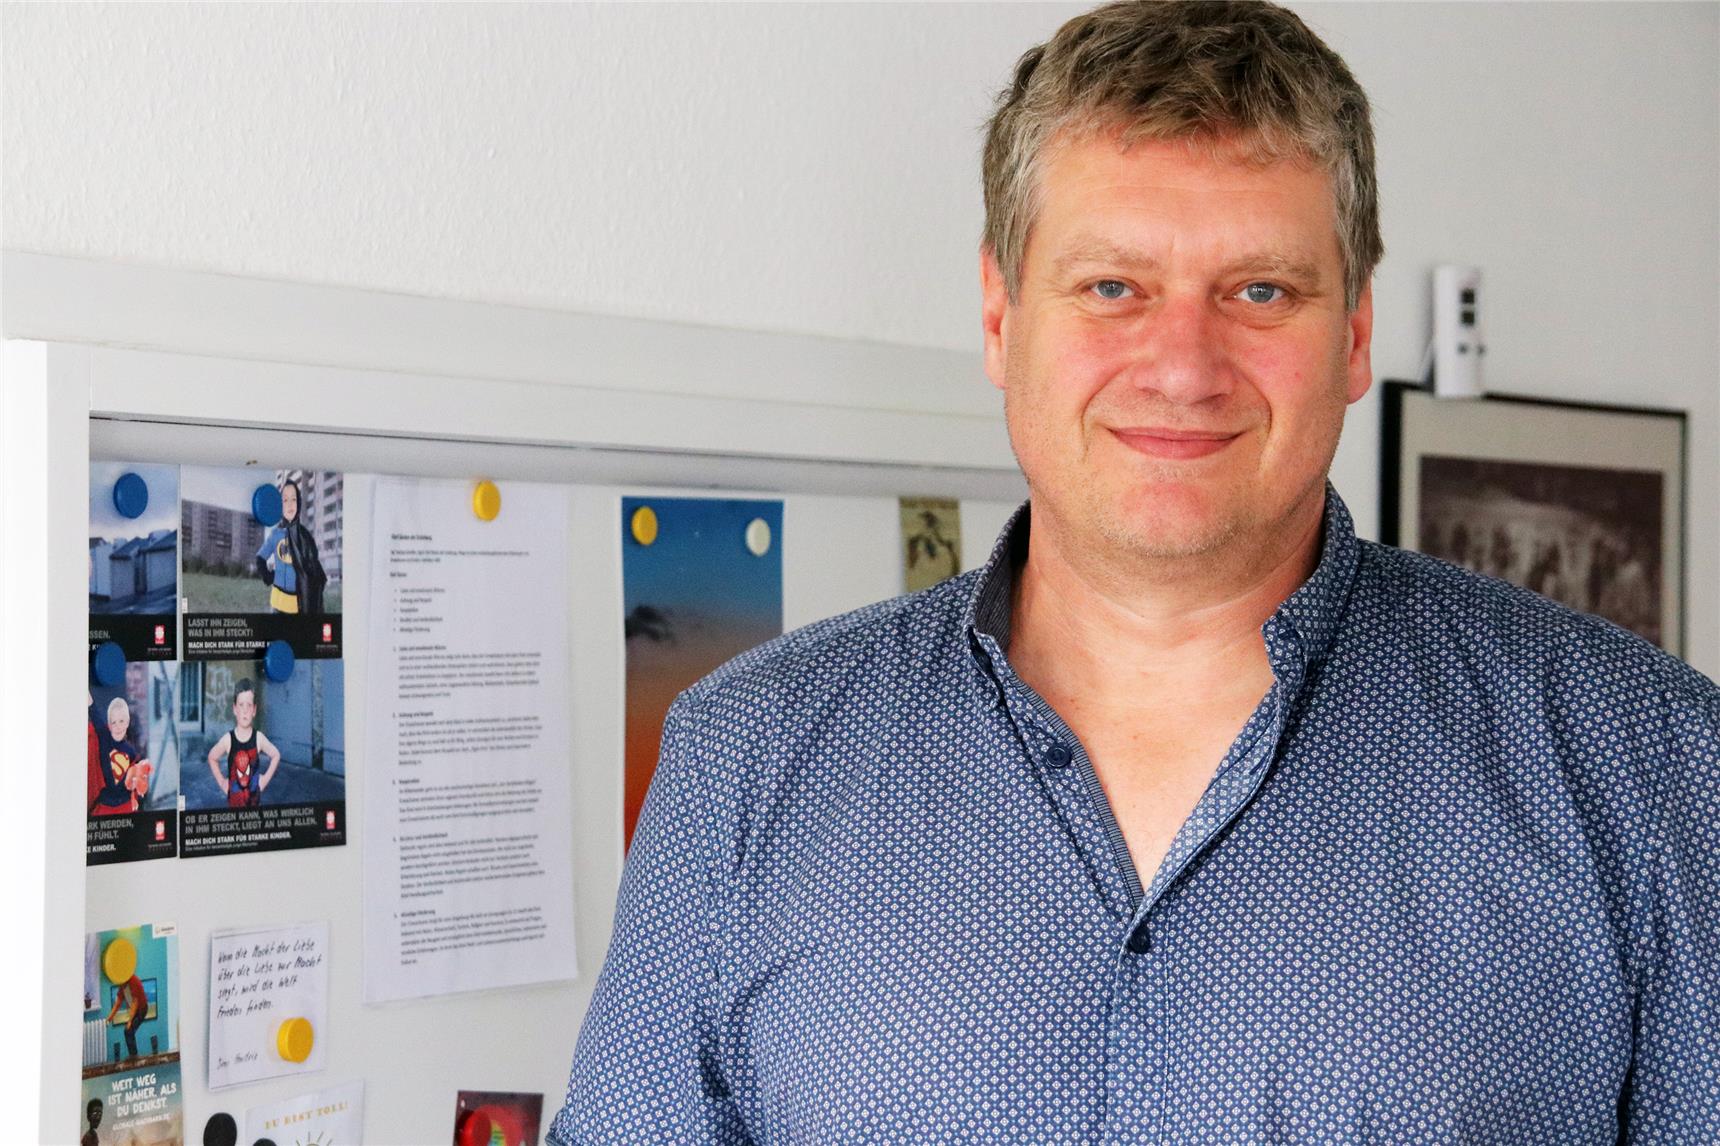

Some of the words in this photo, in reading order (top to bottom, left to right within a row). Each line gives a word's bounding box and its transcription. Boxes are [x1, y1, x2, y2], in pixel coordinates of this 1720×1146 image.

[188, 618, 208, 628] LASST
[188, 628, 204, 638] WAS
[205, 628, 212, 638] IN
[213, 628, 226, 638] IHM
[188, 641, 203, 649] MACH
[204, 641, 217, 649] DICH
[218, 641, 234, 649] STARK
[235, 640, 246, 649] FÜR
[246, 640, 266, 649] STARKE
[185, 815, 196, 824] OB
[198, 814, 208, 823] ER
[210, 812, 237, 822] ZEIGEN
[262, 809, 278, 818] WAS
[280, 807, 314, 817] WIRKLICH
[185, 825, 194, 834] IN
[196, 824, 210, 833] IHM
[241, 820, 262, 831] LIEGT
[264, 819, 274, 828] AN
[277, 818, 292, 828] UNS
[185, 838, 202, 846] MACH
[203, 837, 217, 845] DICH
[217, 835, 235, 844] STARK
[247, 832, 269, 842] STARKE
[235, 947, 247, 960] die
[252, 942, 275, 958] Macht
[276, 941, 291, 954] der
[237, 964, 250, 978] die
[294, 954, 323, 969] Macht
[111, 1077, 134, 1092] WEIT
[136, 1073, 157, 1087] WEG
[107, 1093, 122, 1106] IST
[160, 1082, 177, 1097] ALS
[117, 1104, 129, 1118] DU
